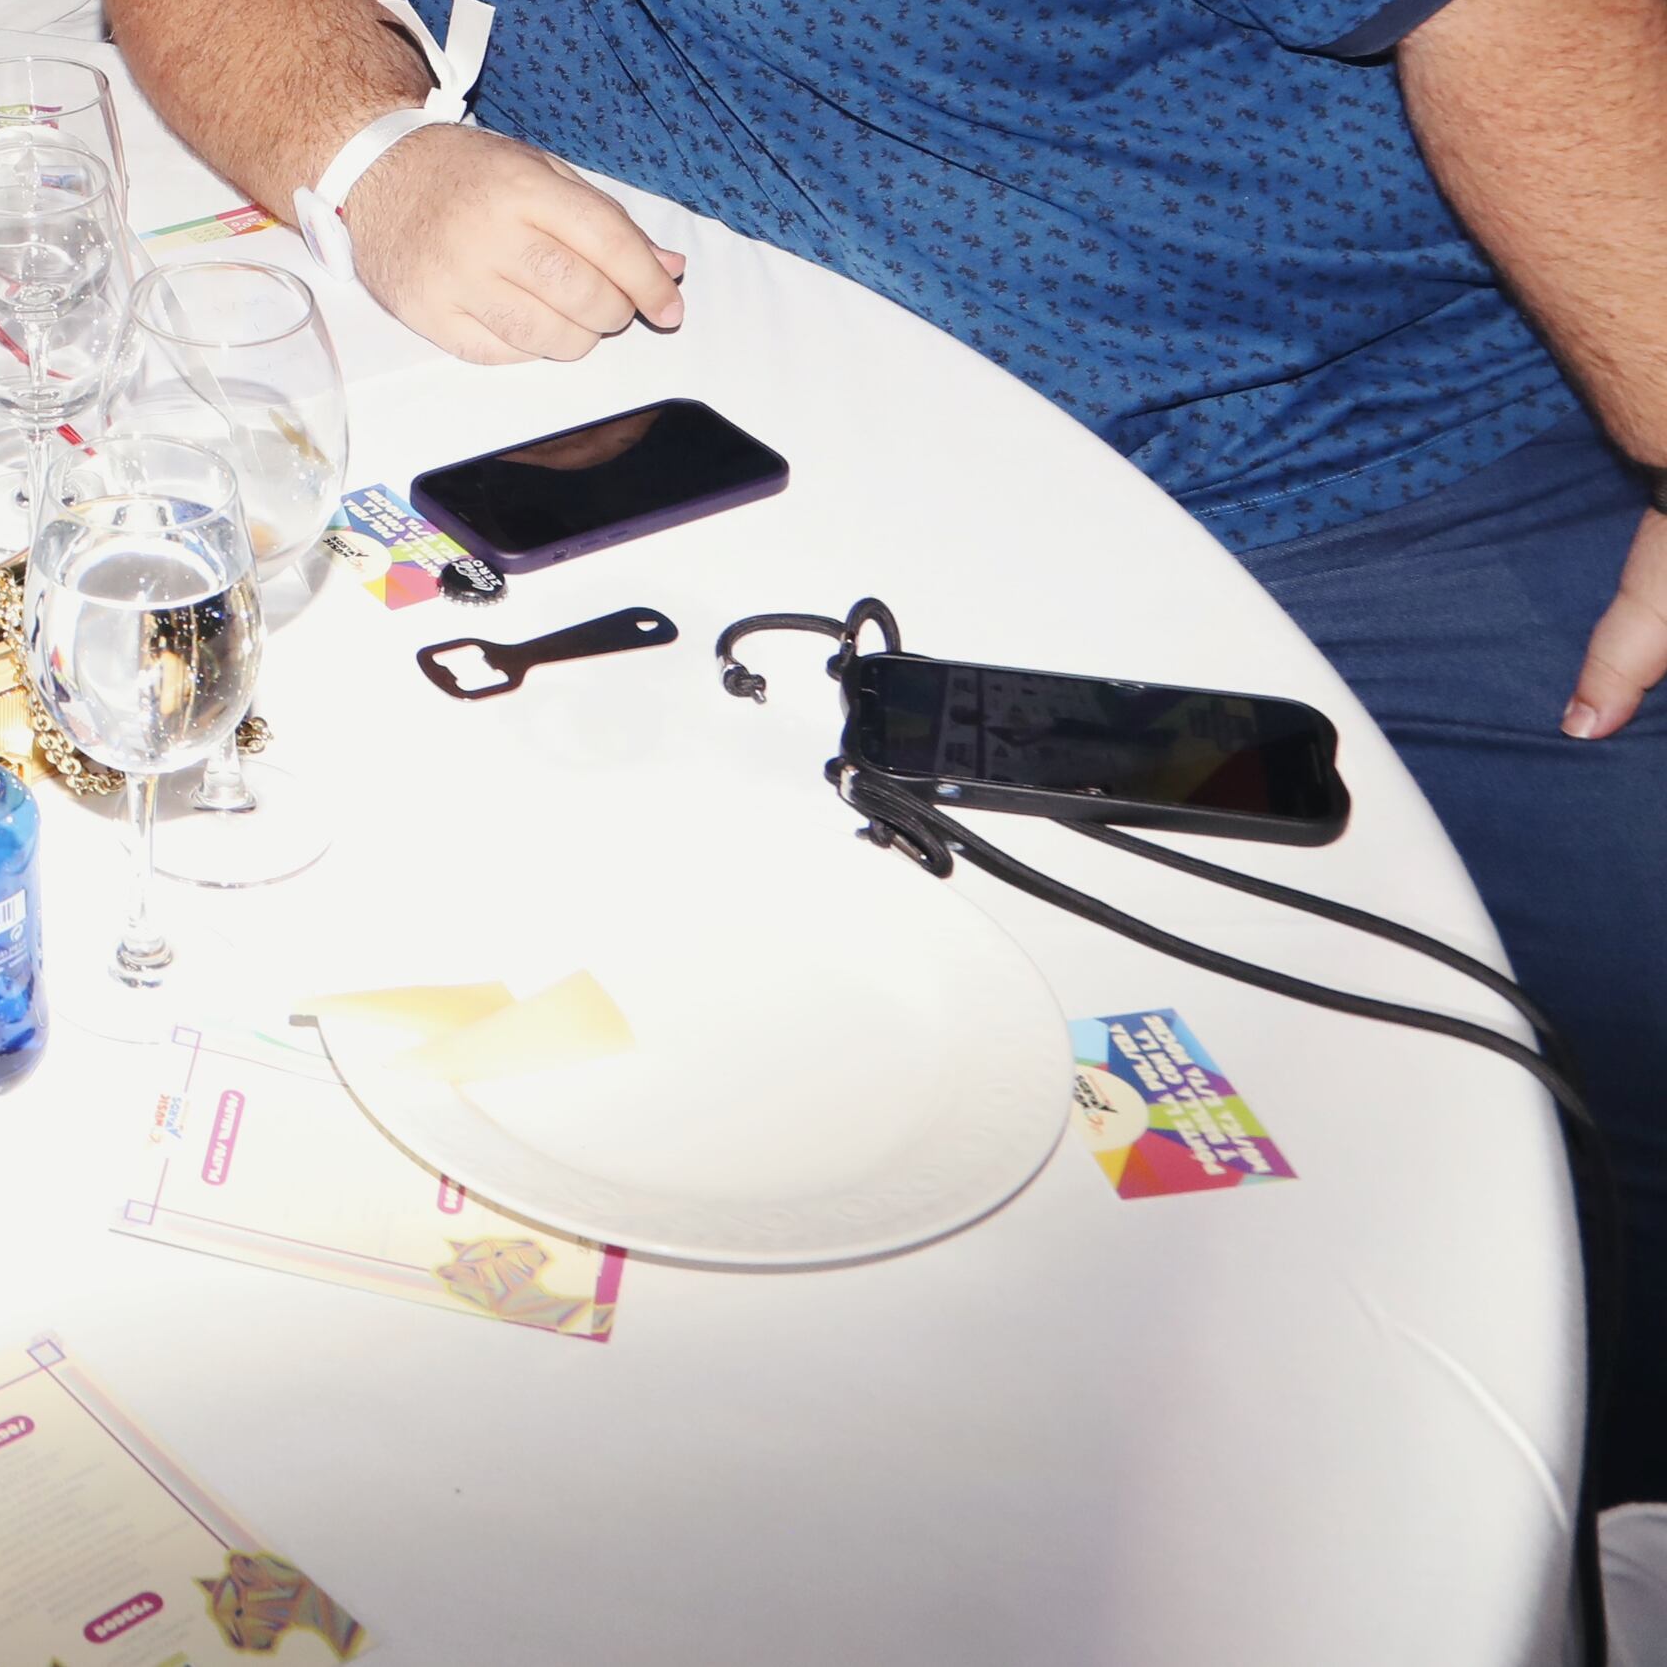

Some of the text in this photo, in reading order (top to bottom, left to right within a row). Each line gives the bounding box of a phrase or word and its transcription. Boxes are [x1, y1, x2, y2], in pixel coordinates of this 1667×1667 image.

[323, 538, 350, 558] MUSIC
[473, 560, 503, 587] ZERO
[155, 1093, 170, 1128] MUSIC
[93, 1597, 155, 1639] BODEGA
